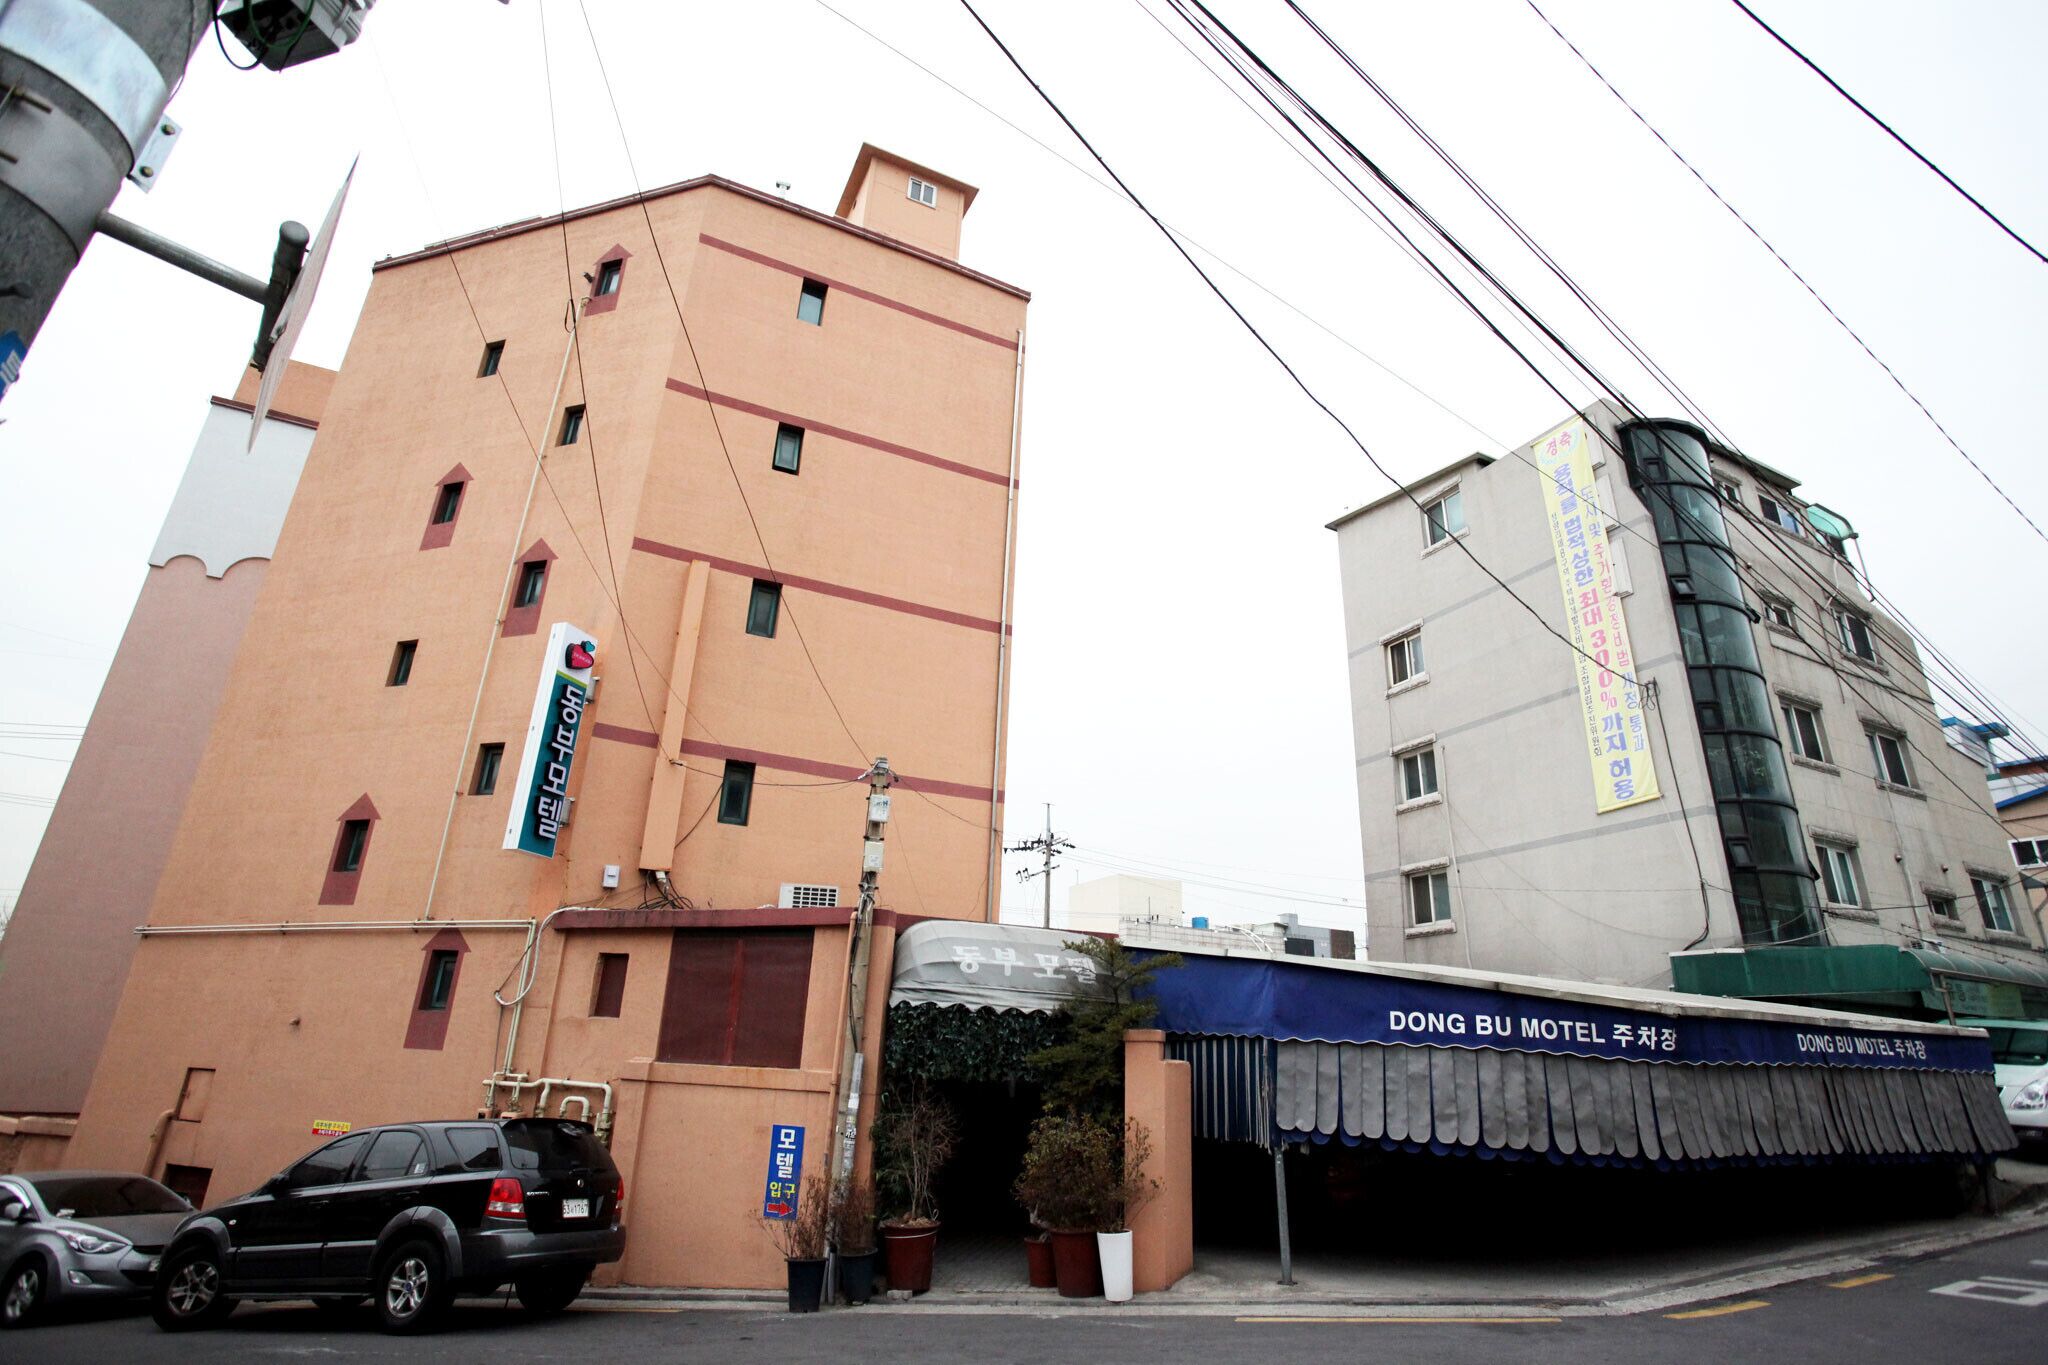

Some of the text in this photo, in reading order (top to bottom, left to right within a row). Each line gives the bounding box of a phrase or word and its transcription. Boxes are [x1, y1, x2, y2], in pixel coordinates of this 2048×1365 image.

[1545, 431, 1572, 456] 경축
[1578, 587, 1604, 627] 최대
[1601, 711, 1628, 753] 까지
[1628, 713, 1645, 753] 통과
[538, 684, 584, 840] 동부모텔
[1608, 757, 1635, 801] 허용
[951, 945, 1097, 985] 동부 모텔
[1388, 1010, 1678, 1051] DONG BU MOTEL 주차장
[1796, 1033, 1928, 1060] DONG BU MOTEL 주차장
[776, 1128, 797, 1179] 모텔
[769, 1181, 797, 1199] 입구
